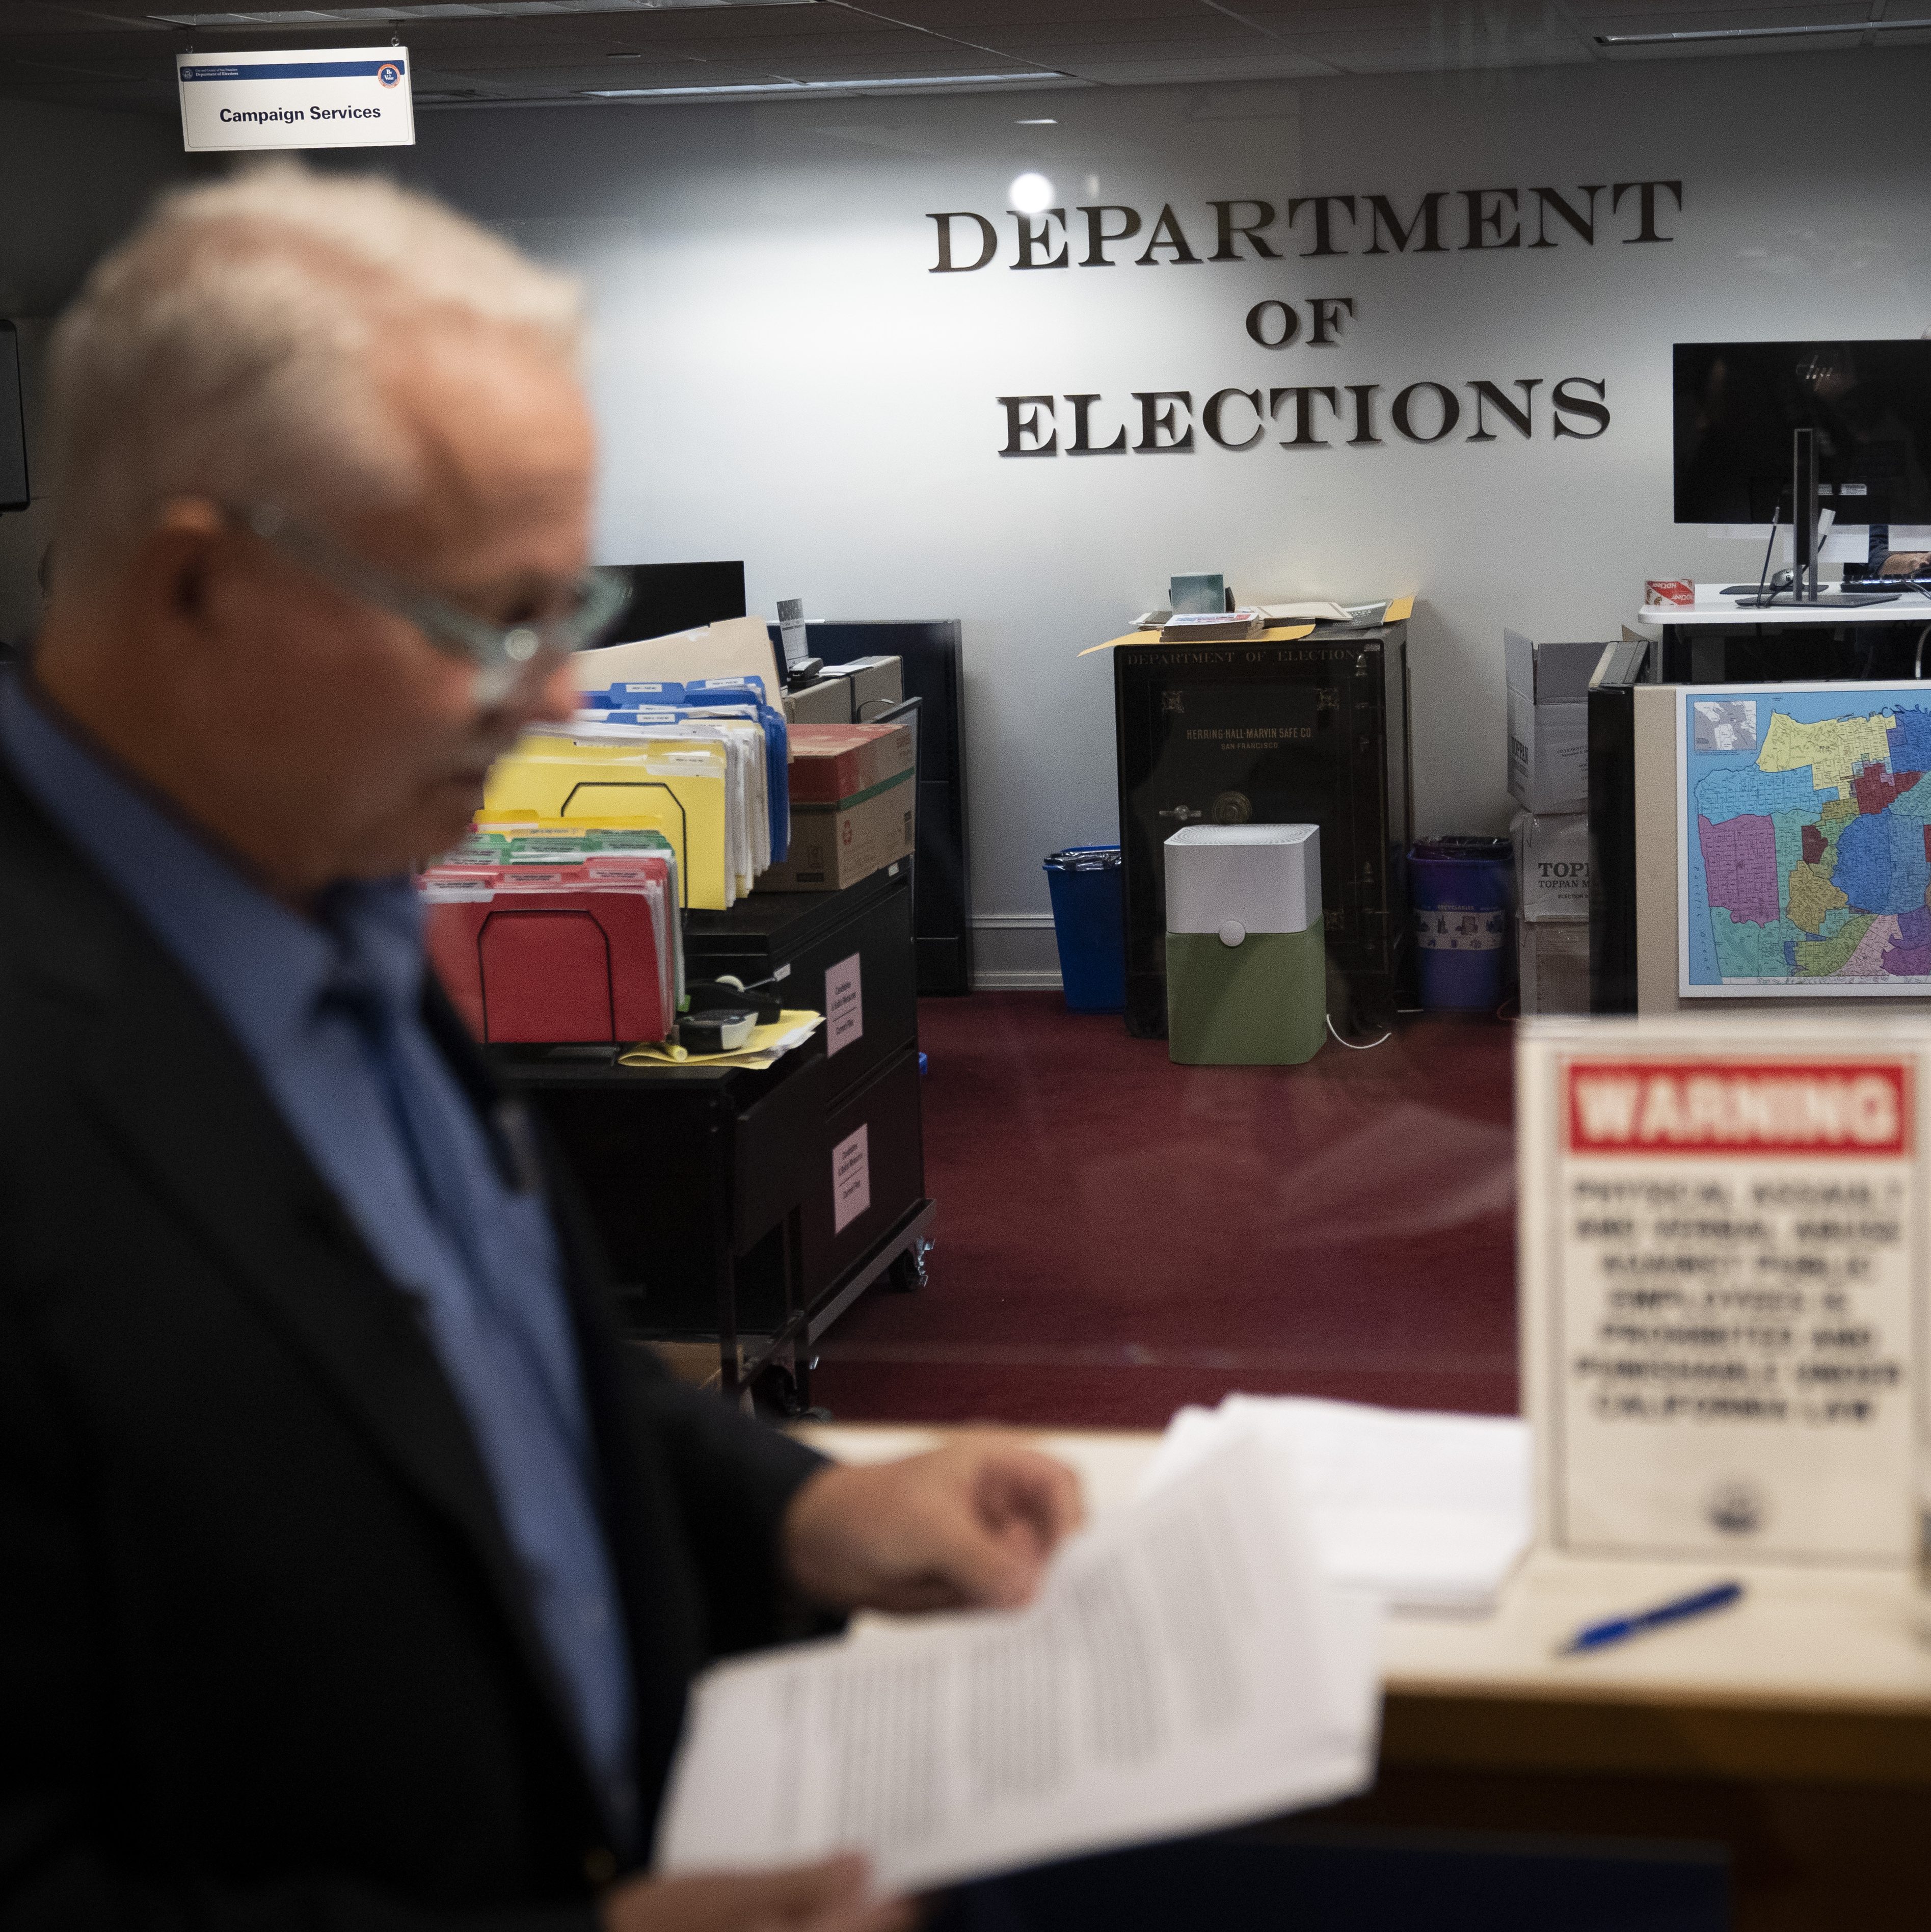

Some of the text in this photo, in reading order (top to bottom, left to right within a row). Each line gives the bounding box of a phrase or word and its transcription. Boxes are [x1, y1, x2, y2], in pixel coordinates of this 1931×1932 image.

[220, 105, 381, 124] Campaign Services
[925, 180, 1683, 273] DEPARTMENT
[1246, 298, 1353, 350] OF
[996, 377, 1611, 457] ELECTIONS
[1128, 649, 1363, 665] DEPARTMENT OF ELECTION
[1279, 728, 1298, 738] SAFE
[1539, 880, 1578, 888] TOPPAN
[1575, 1073, 1900, 1144] WARNING
